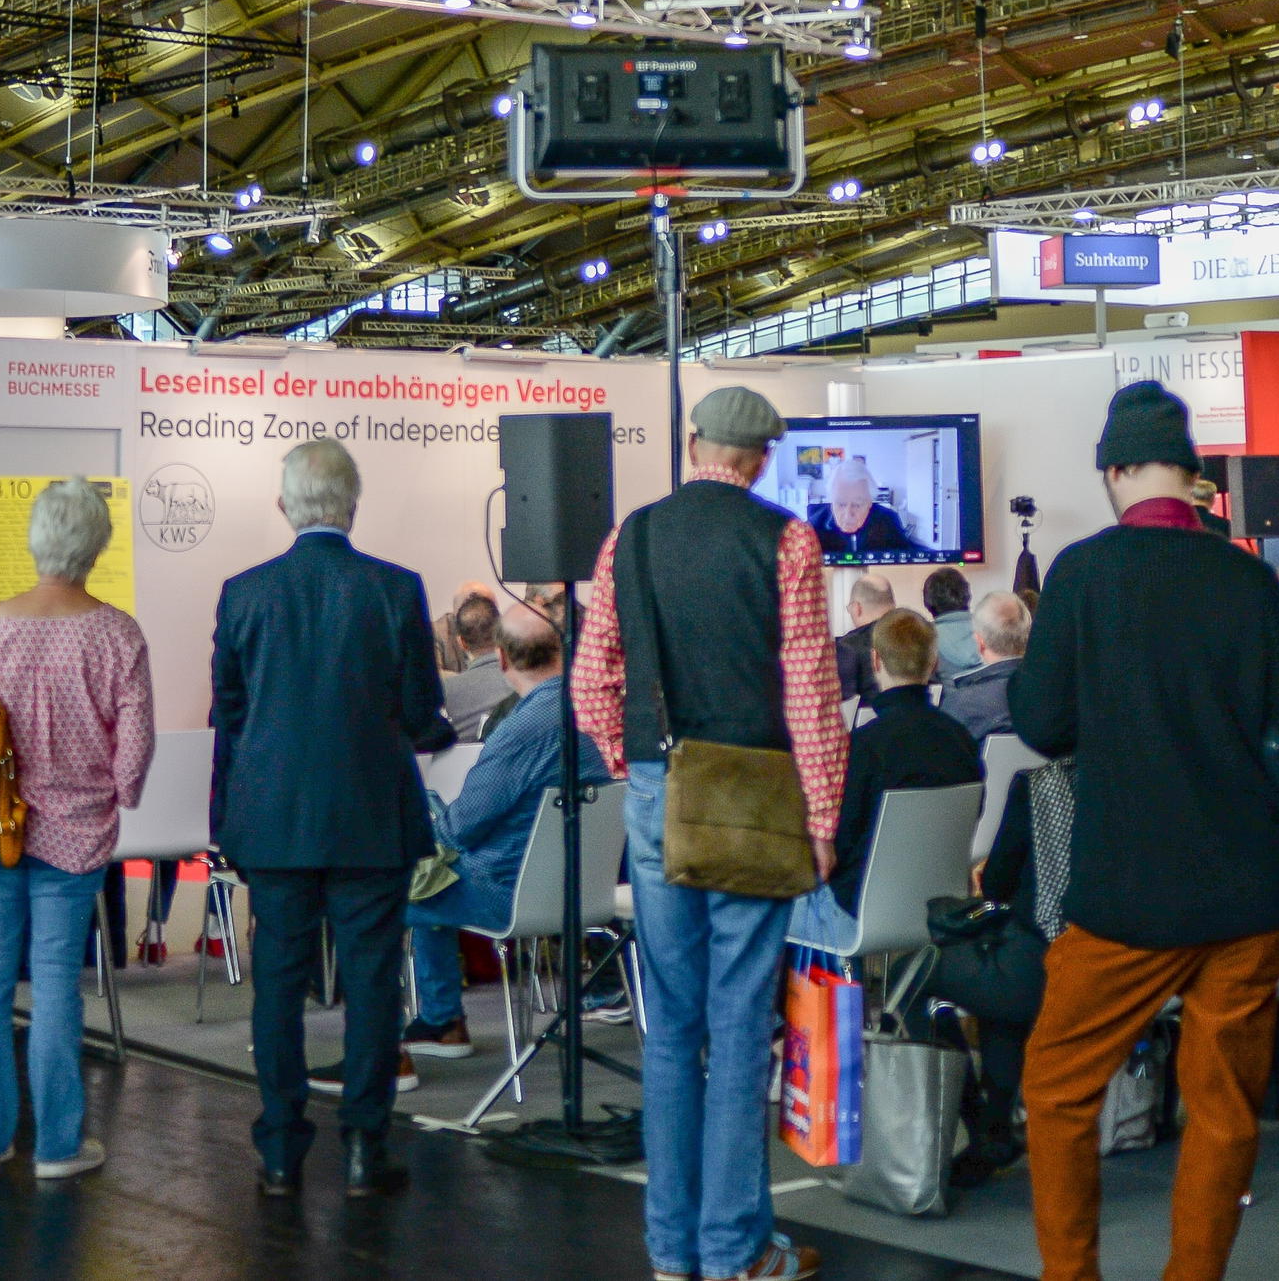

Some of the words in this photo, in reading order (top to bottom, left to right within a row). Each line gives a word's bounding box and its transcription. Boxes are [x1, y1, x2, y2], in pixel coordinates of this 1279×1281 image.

[1075, 251, 1149, 270] Suhrkamp
[1193, 259, 1227, 280] DIE
[8, 361, 116, 380] FRANKFURTER
[7, 381, 100, 398] BUCHMESSE
[140, 366, 265, 397] Leseinsel
[272, 373, 318, 398] der
[325, 374, 510, 408] unabhängigen
[516, 378, 607, 411] Verlage
[140, 411, 255, 446] Reading
[262, 413, 328, 440] Zone
[334, 415, 360, 440] of
[367, 416, 500, 448] Independe
[159, 527, 196, 544] KWS
